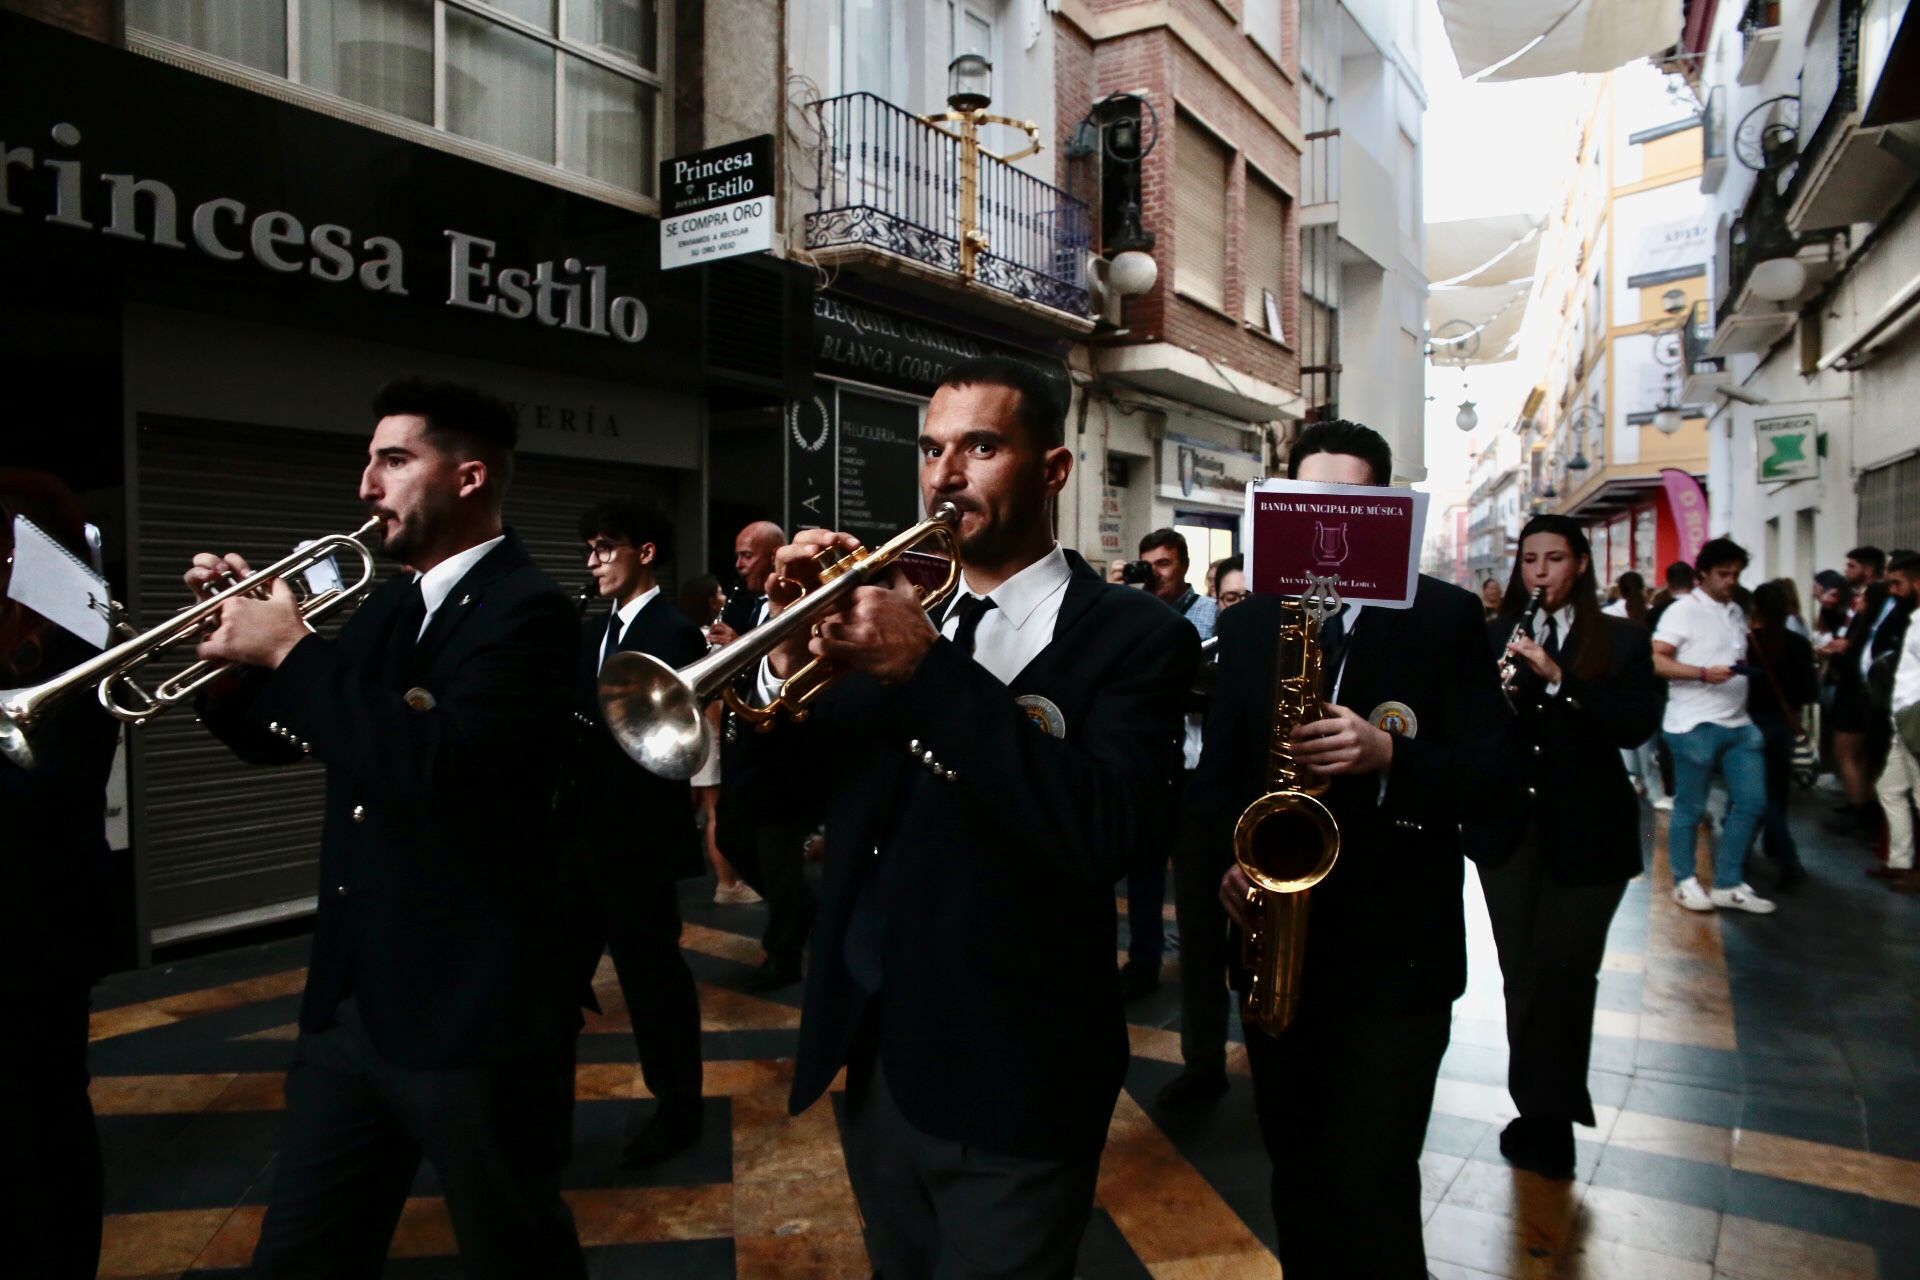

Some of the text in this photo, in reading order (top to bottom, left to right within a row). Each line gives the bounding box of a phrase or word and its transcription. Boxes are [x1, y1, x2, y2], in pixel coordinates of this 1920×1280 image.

[674, 152, 754, 184] Princesa
[707, 175, 754, 201] Estilo
[0, 122, 648, 343] rincesa Estilo
[665, 202, 763, 238] SE COMPRA ORO
[820, 334, 951, 384] BLANCA CORD
[511, 401, 620, 438] YERÍA
[1260, 501, 1404, 516] BANDA MUNICIPAL DE MÚSICA
